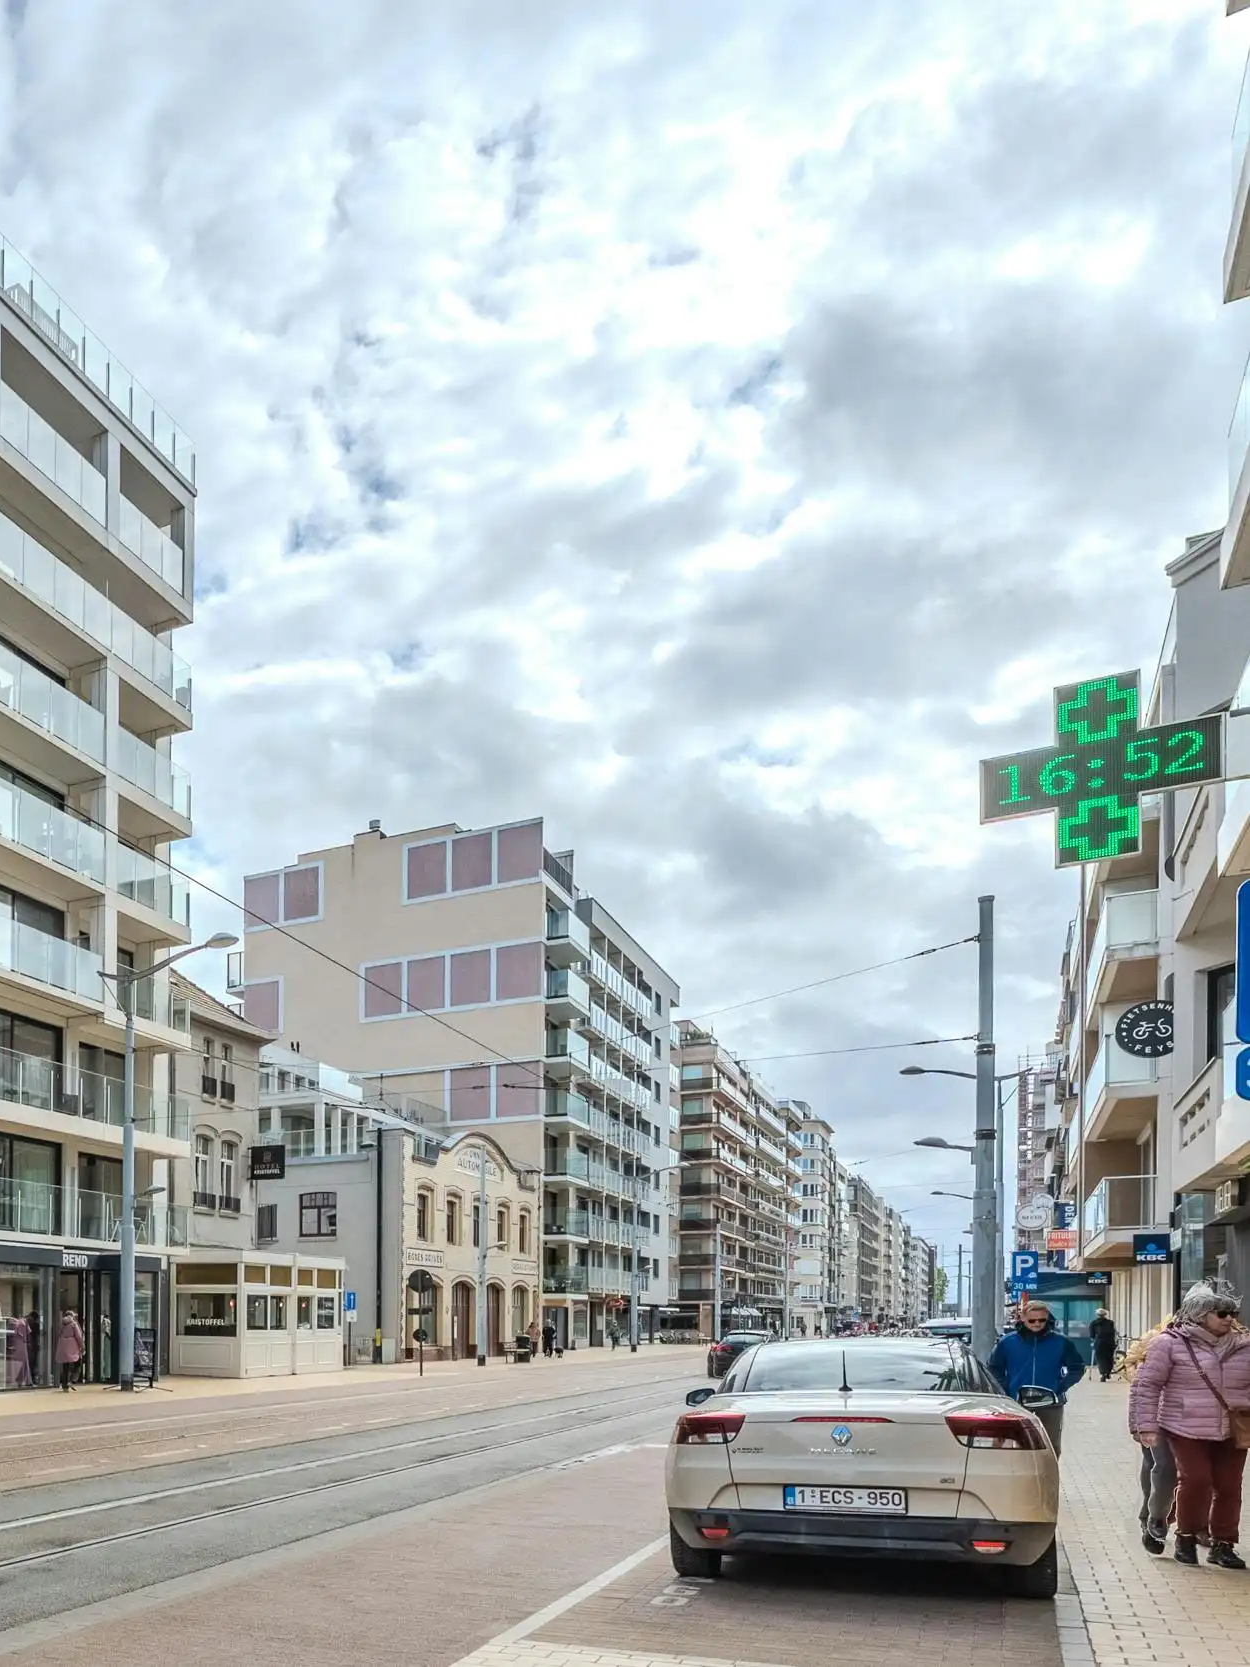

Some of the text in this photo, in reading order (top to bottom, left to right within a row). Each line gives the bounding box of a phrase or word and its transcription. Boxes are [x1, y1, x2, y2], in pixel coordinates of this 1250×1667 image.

[998, 730, 1205, 805] 16:52
[1134, 1040, 1174, 1053] FEYS
[458, 1157, 497, 1177] AUTOMBILE
[62, 1253, 89, 1268] REND
[1015, 1255, 1035, 1277] P
[1013, 1282, 1024, 1290] 30
